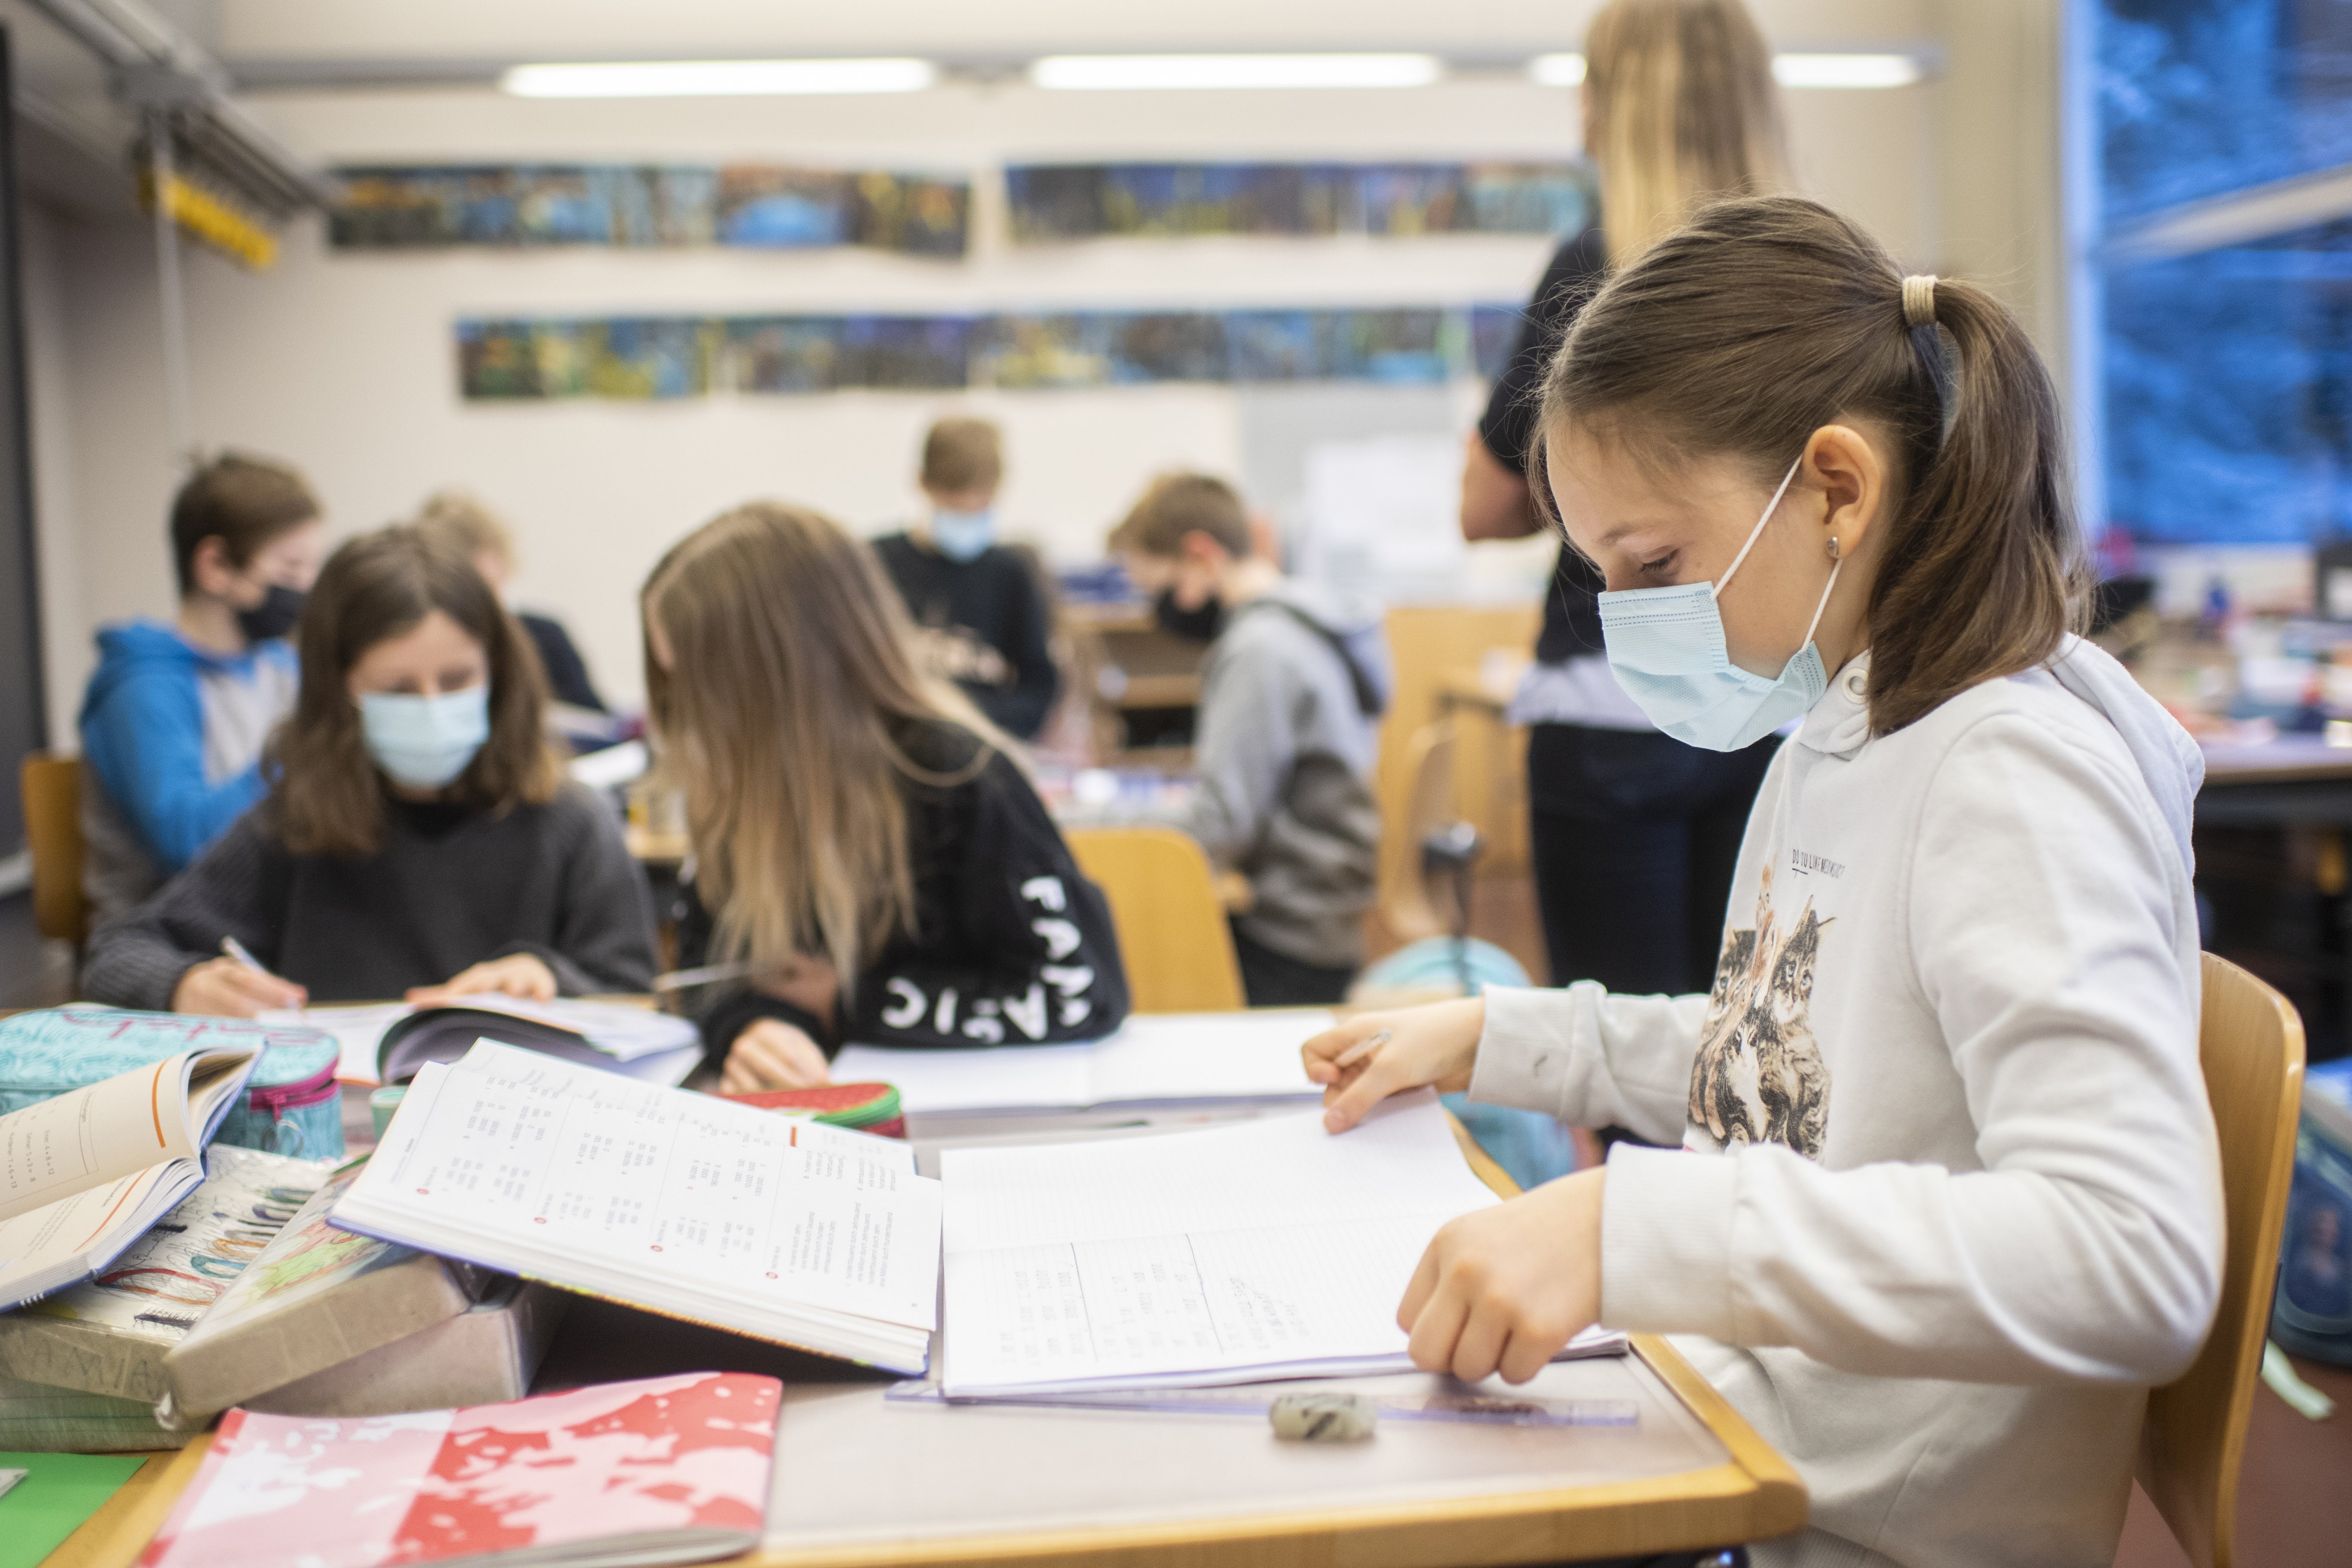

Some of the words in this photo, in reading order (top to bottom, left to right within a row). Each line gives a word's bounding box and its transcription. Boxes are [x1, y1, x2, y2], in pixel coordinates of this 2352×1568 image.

[1792, 849, 1799, 864] DO
[852, 1202, 860, 1230] zehntausend
[862, 1213, 870, 1241] zehntausend
[883, 1212, 892, 1246] hunderttausend
